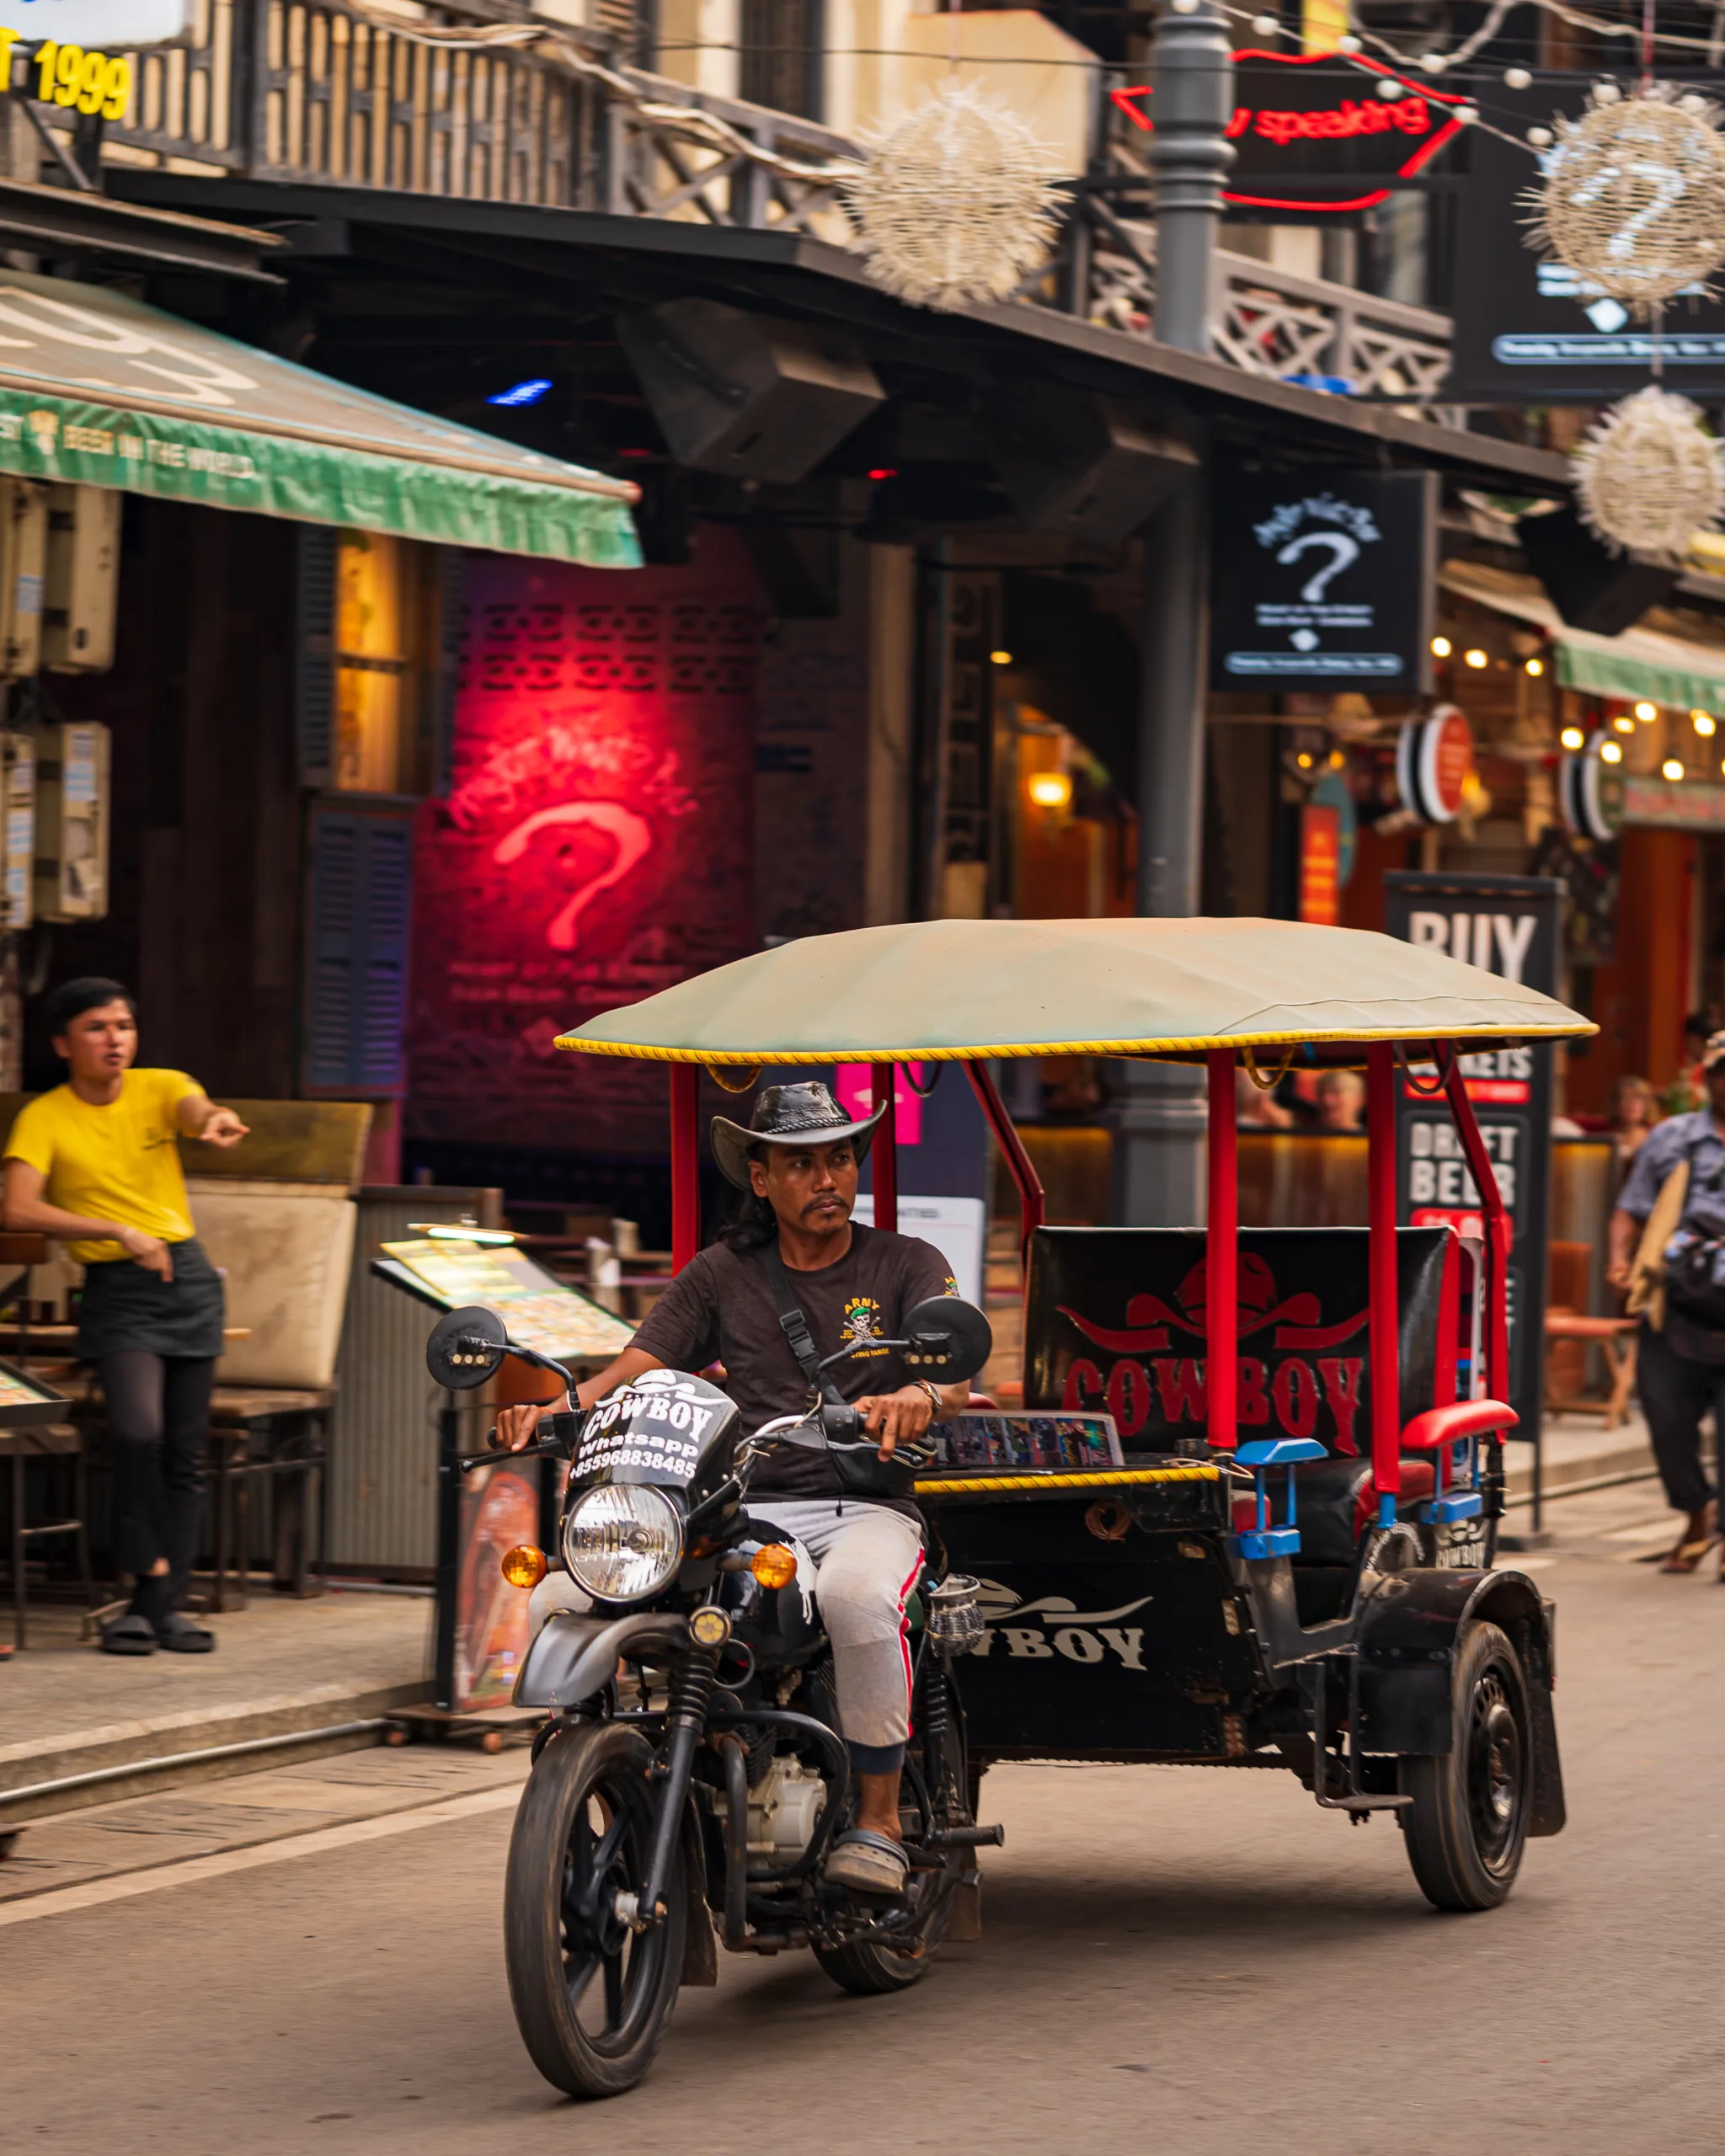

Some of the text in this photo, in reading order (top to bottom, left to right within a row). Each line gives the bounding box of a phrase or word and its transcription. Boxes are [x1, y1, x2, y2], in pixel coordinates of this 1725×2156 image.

[34, 40, 132, 120] 1999
[1253, 97, 1432, 146] speaking
[63, 424, 115, 455] BEER
[118, 434, 143, 459] IN
[146, 438, 186, 468] THE
[1410, 1122, 1519, 1161] DRFT
[844, 1297, 881, 1315] ARMY
[583, 1396, 713, 1444] COWBOY
[1060, 1356, 1364, 1457] COWBOY
[569, 1449, 697, 1480] +855968838485
[578, 1432, 699, 1460] Whatsapp
